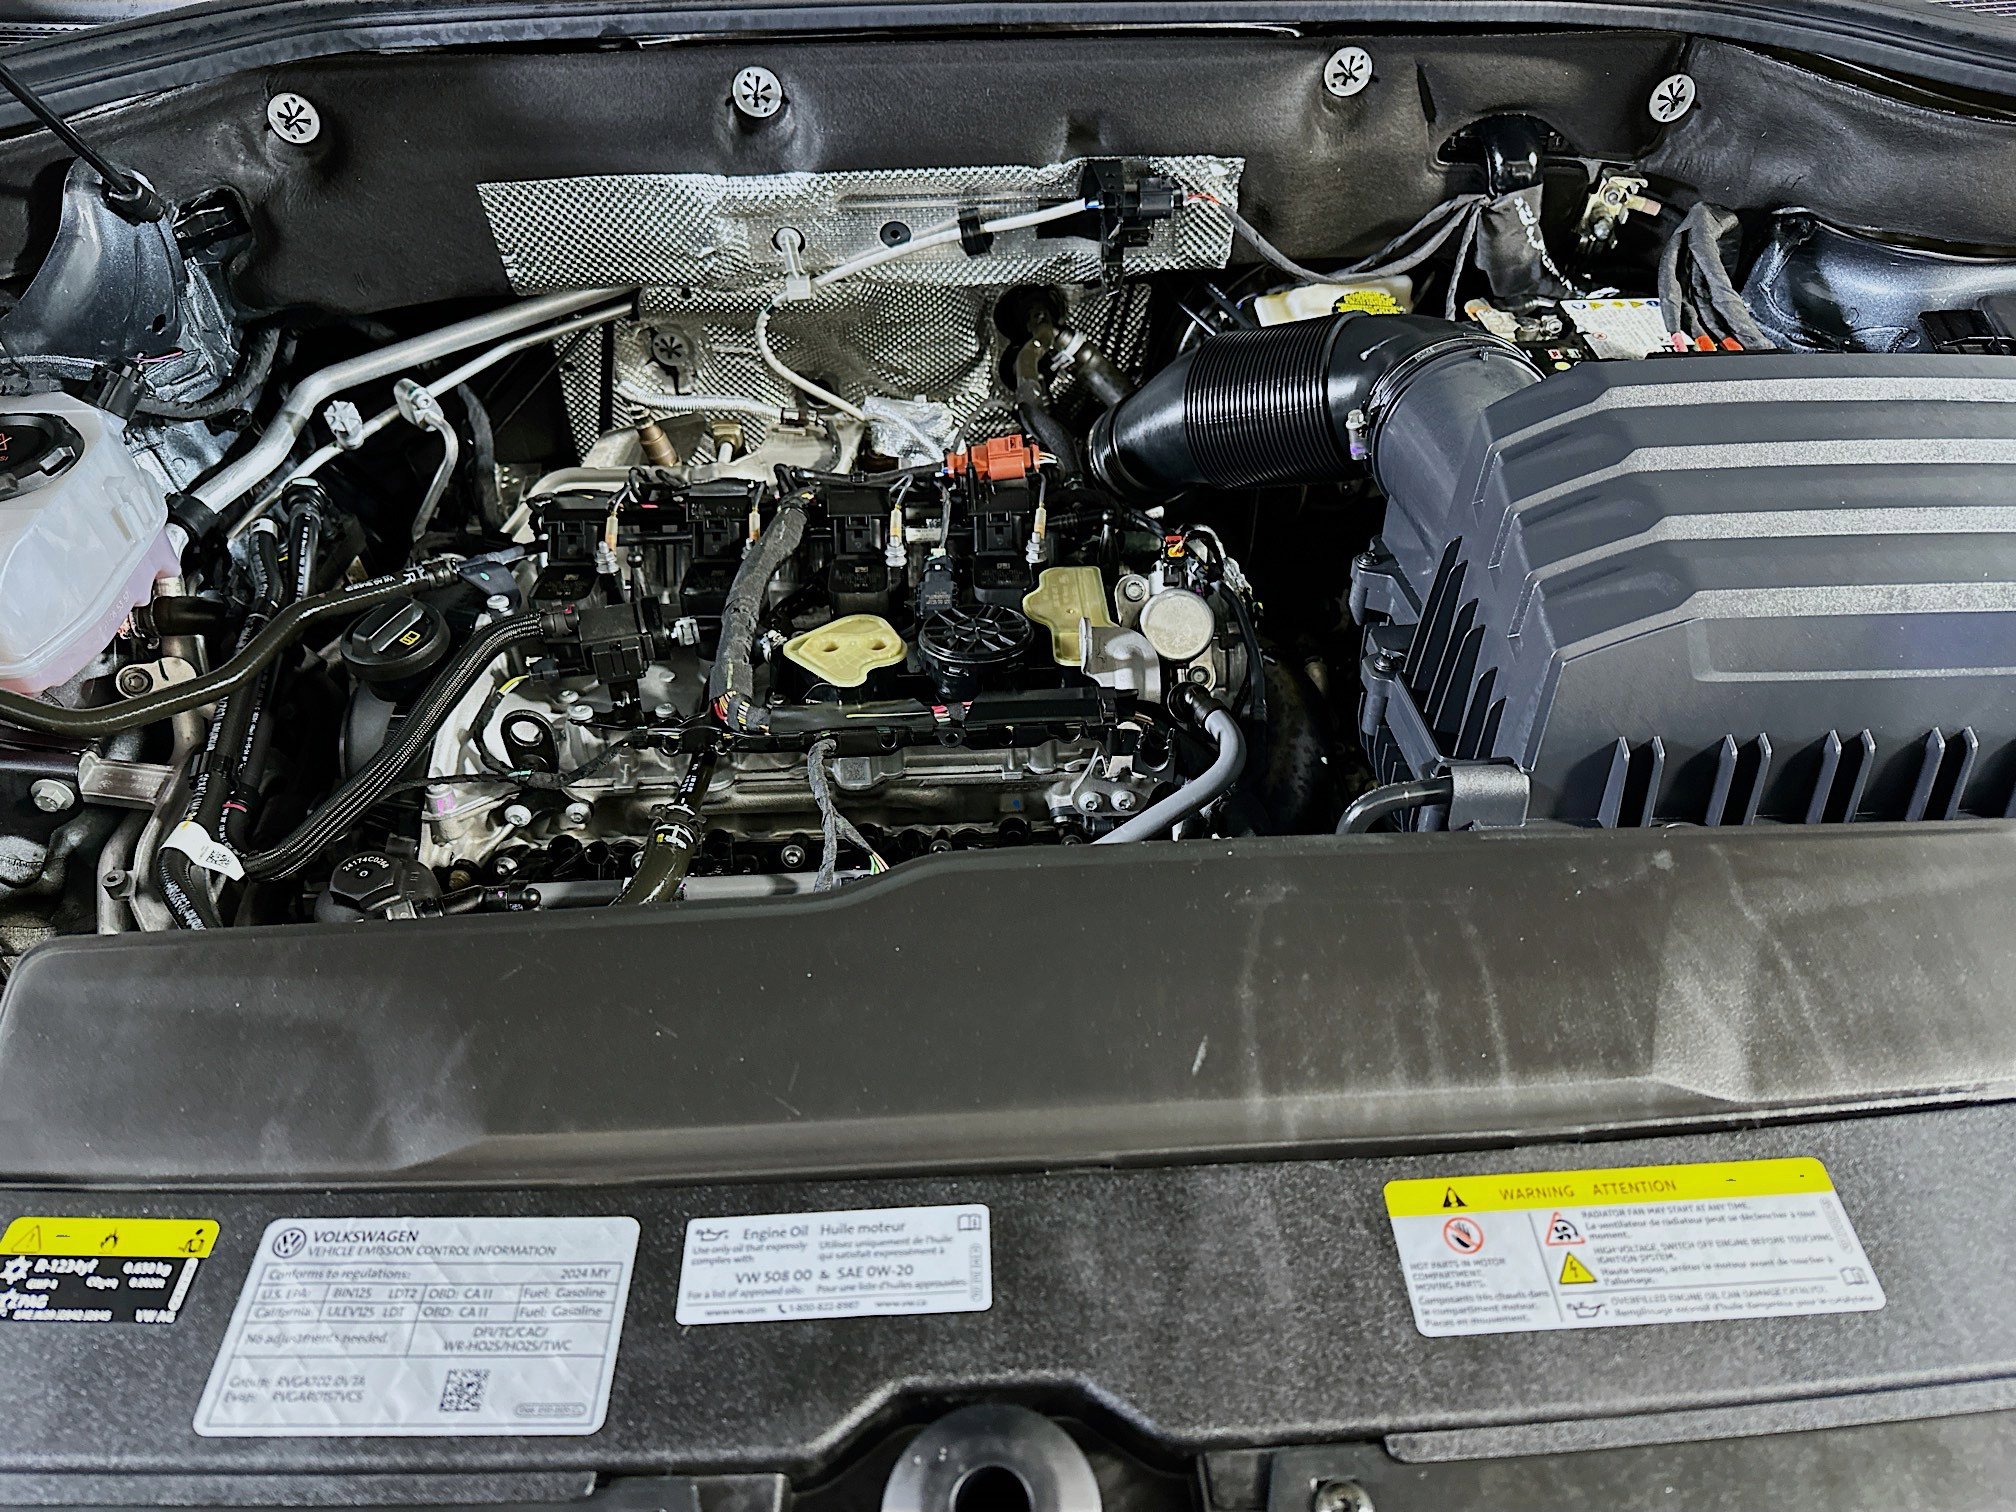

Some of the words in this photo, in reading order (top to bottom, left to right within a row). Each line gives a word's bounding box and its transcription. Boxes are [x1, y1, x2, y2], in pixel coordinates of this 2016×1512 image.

[1499, 1184, 1576, 1202] WARNING
[1593, 1180, 1677, 1197] ATTENTION
[743, 1227, 787, 1242] Engine
[789, 1225, 810, 1238] Oil
[820, 1223, 855, 1237] Huile
[858, 1221, 906, 1234] moteur
[313, 1230, 420, 1244] VOLKSWAGEN
[307, 1245, 354, 1258] VEHICLE
[357, 1245, 415, 1258] EMISSION
[416, 1245, 470, 1257] CONTROL
[472, 1245, 558, 1257] INFORMATION
[269, 1268, 324, 1282] Conforms
[325, 1270, 337, 1280] to
[560, 1268, 588, 1280] 2024
[590, 1268, 612, 1279] MY
[735, 1272, 762, 1284] VW
[793, 1269, 813, 1281] 00
[819, 1271, 830, 1280] &
[838, 1265, 864, 1279] SAE
[867, 1264, 915, 1278] 0W-20
[333, 1286, 373, 1299] BIN125
[387, 1287, 418, 1300] LDT2
[464, 1287, 482, 1299] CA
[555, 1287, 608, 1299] Gasoline
[458, 1306, 477, 1318] CA
[551, 1305, 604, 1317] Gasoline
